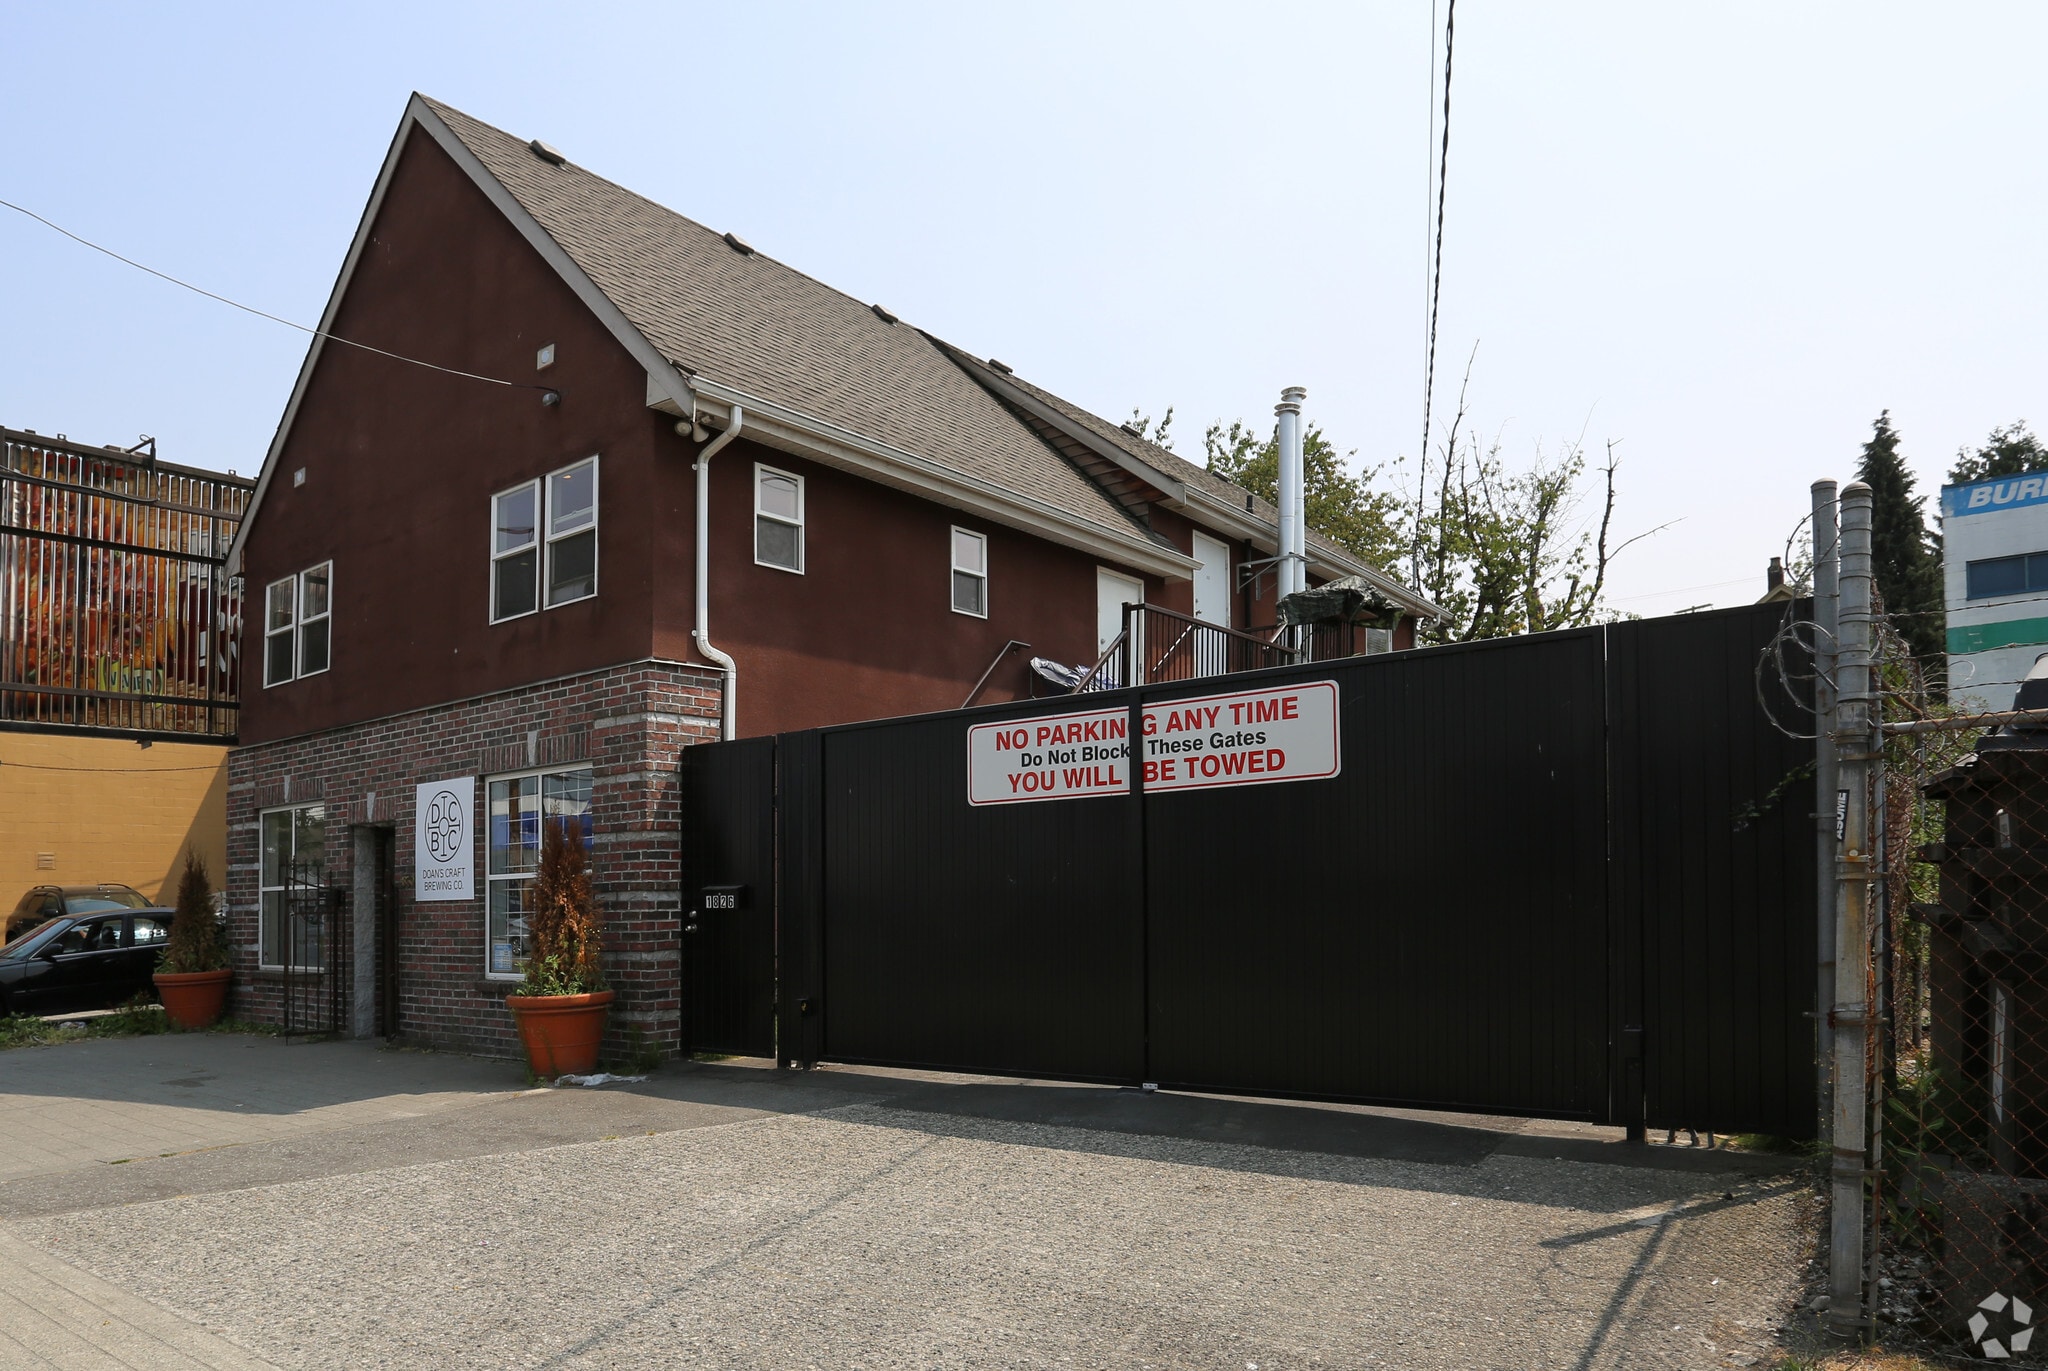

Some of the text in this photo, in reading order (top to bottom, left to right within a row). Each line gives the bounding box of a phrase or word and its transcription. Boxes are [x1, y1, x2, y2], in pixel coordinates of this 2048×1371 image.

[996, 696, 1298, 751] NO PARKING ANY TIME
[1021, 731, 1266, 767] Do Not Block These Gates
[1008, 749, 1286, 793] YOU WILL BE TOWED
[445, 867, 465, 878] CRAFT
[424, 881, 452, 891] BREWING
[706, 895, 734, 909] 1826
